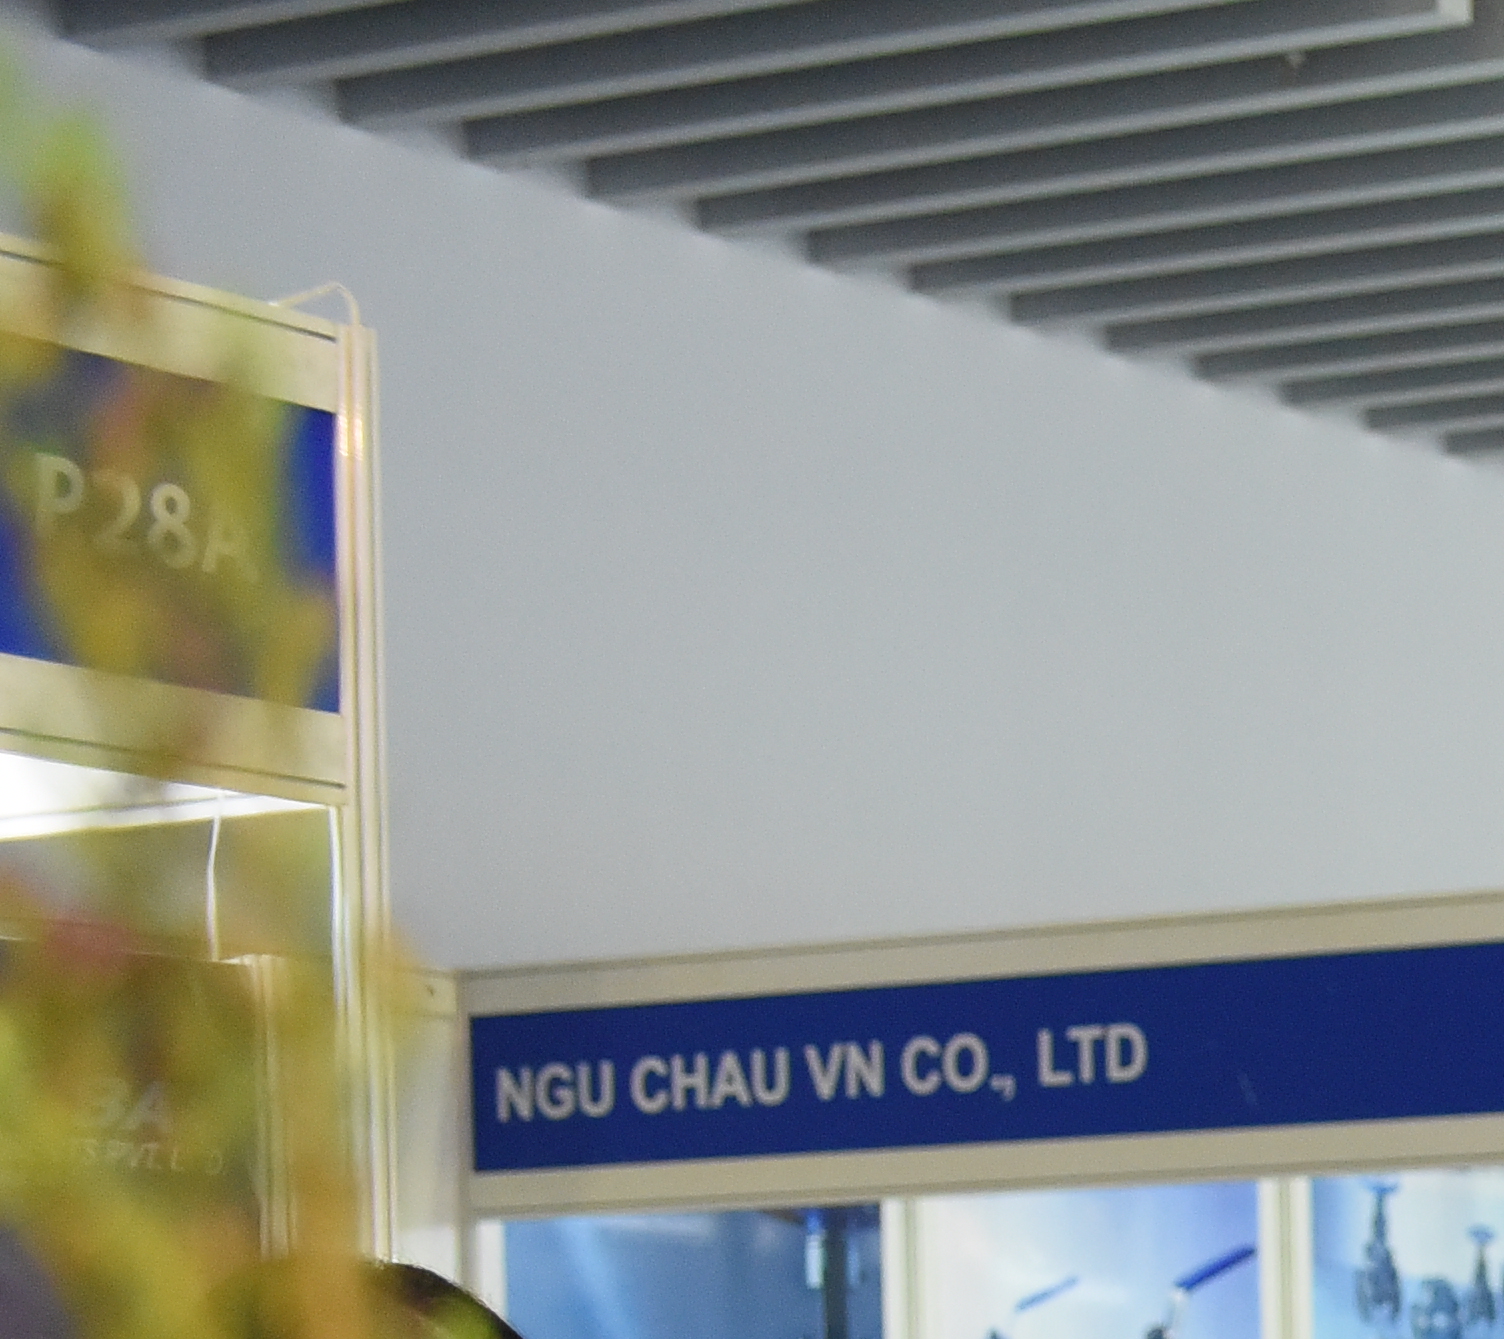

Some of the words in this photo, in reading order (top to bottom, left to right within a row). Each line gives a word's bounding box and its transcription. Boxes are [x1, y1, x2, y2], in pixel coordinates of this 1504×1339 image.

[496, 1060, 615, 1123] NGU
[630, 1046, 792, 1115] CHAU
[805, 1037, 885, 1100] VN
[1036, 1022, 1148, 1086] LTD
